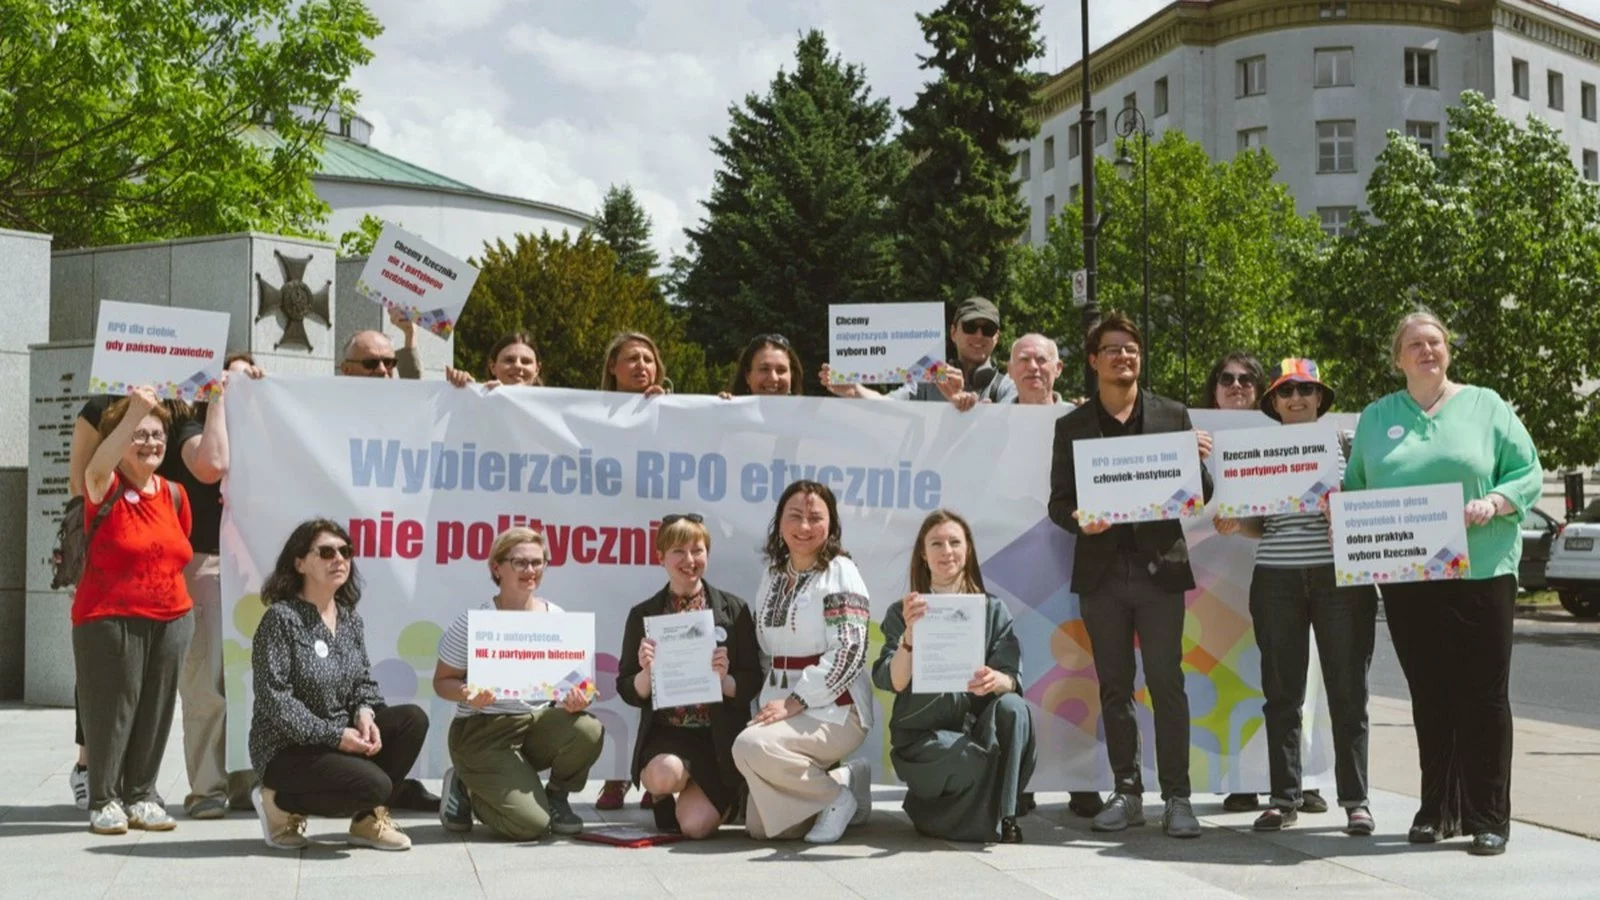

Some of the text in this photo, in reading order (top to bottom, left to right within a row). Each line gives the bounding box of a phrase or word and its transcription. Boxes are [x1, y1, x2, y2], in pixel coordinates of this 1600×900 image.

[394, 240, 457, 281] Chcemy Rzecznika
[387, 255, 400, 266] nie
[404, 264, 443, 290] partyjnego
[381, 268, 426, 297] rozdzielnika!
[836, 316, 869, 326] Chcemy
[107, 321, 178, 338] RPO dla ciebie,
[836, 329, 941, 341] najwyższych standardów
[105, 340, 214, 359] gdy państwo zawiedzie
[836, 346, 886, 357] wyboru RPO
[1092, 451, 1178, 467] RPO zawsze na linii
[1223, 444, 1327, 461] Rzecznik naszych praw,
[349, 438, 622, 494] Wybierzcie
[635, 450, 728, 502] RPO
[1093, 468, 1182, 484] człowiek-instytucja
[1224, 462, 1318, 478] nie partyjnych spraw
[1344, 496, 1428, 512] Wysłuchanie głosu
[1345, 515, 1396, 529] obywatelek
[1403, 511, 1448, 523] obywateli
[349, 511, 424, 559] nie
[1346, 531, 1414, 545] dobra praktyka
[1348, 546, 1427, 561] wyboru Rzecznika
[475, 631, 493, 641] RPO
[503, 632, 562, 643] autorytetem,
[475, 648, 585, 660] NIE z partyjnym biletem!
